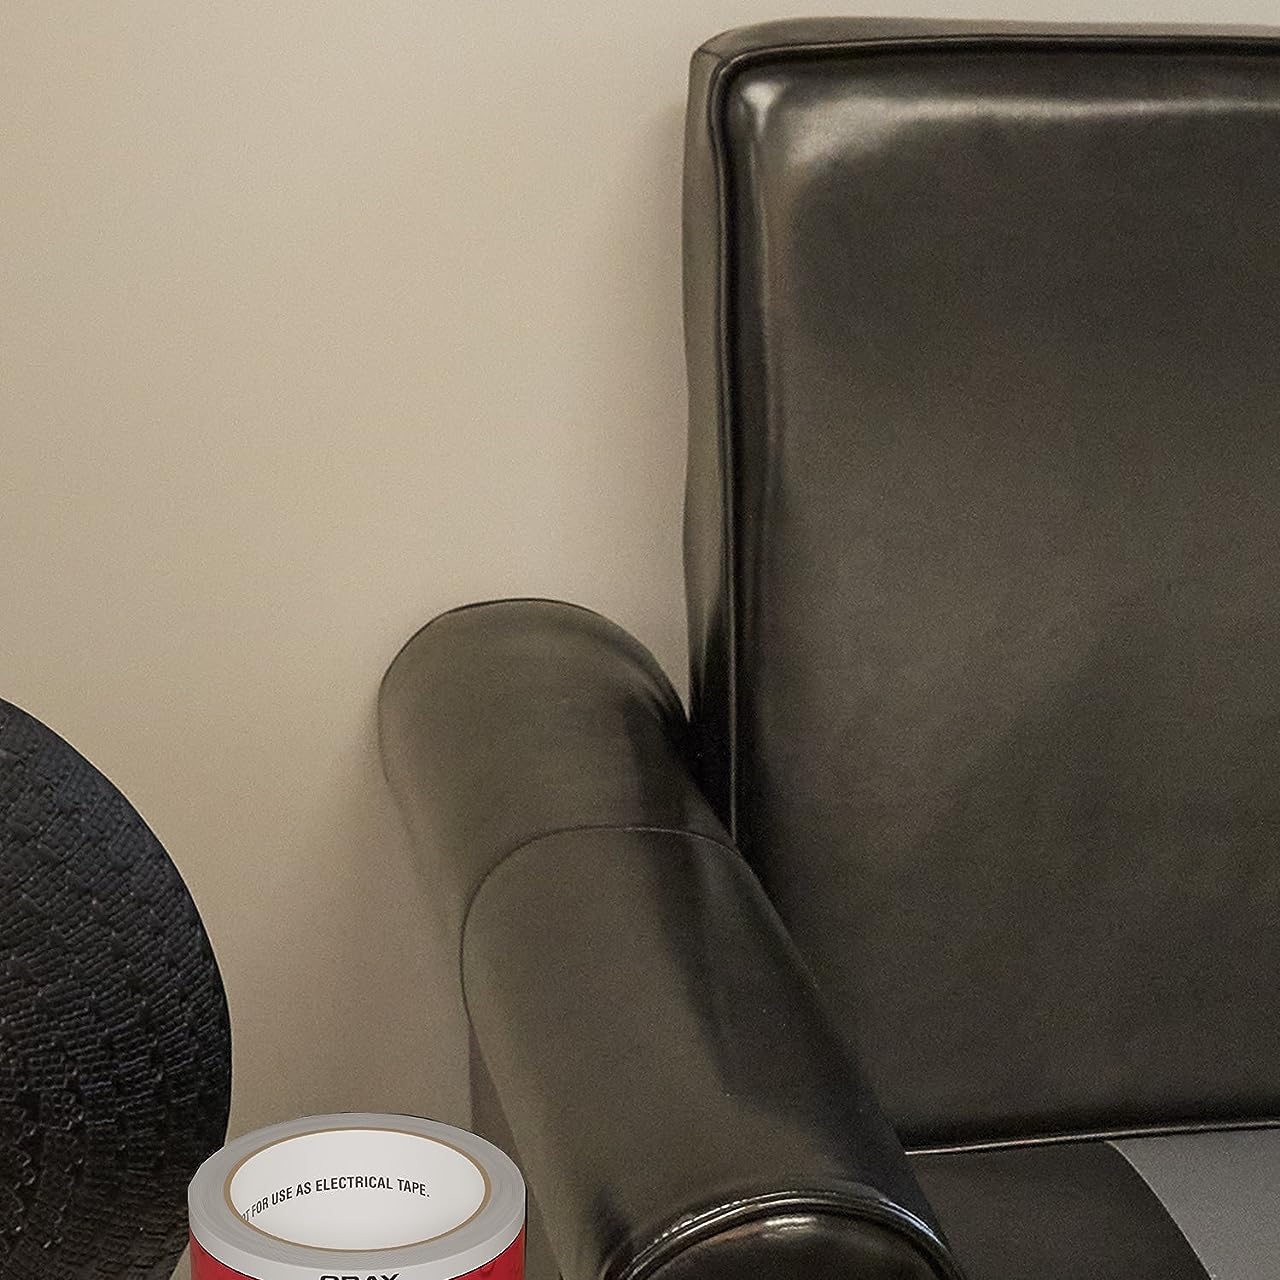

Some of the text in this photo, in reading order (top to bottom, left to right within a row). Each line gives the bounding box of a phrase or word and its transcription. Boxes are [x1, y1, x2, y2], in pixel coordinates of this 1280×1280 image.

[251, 1197, 269, 1217] FOR
[271, 1186, 293, 1205] USE
[296, 1181, 312, 1197] AS
[315, 1176, 393, 1192] ELECTRICAL
[397, 1178, 430, 1198] TAPE.
